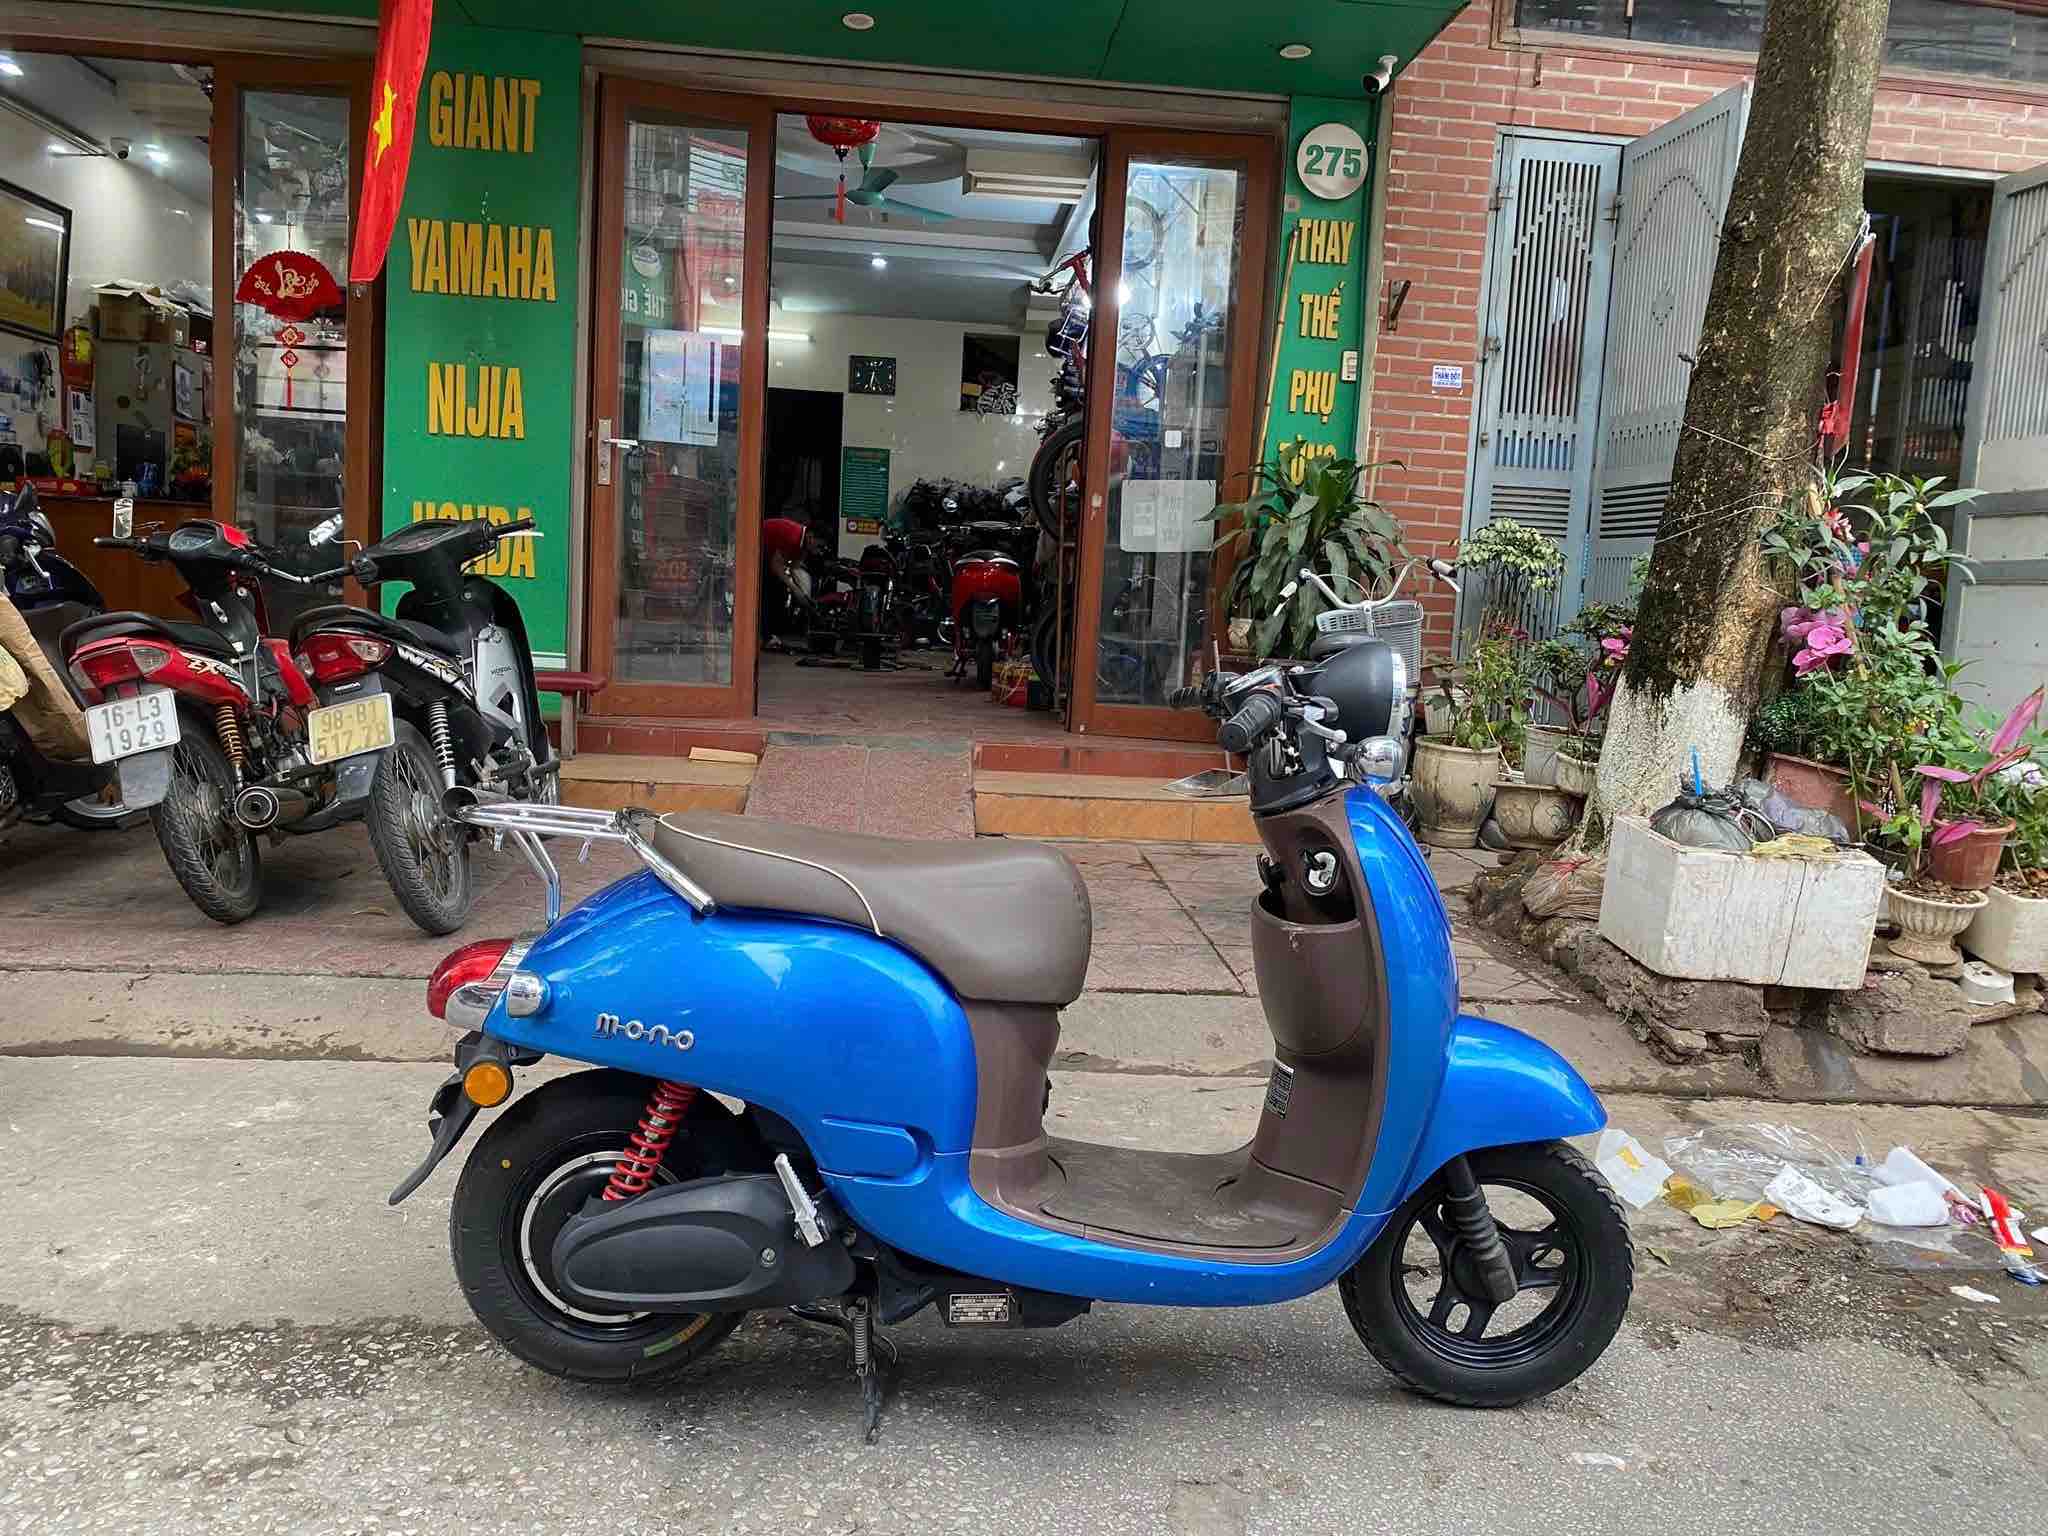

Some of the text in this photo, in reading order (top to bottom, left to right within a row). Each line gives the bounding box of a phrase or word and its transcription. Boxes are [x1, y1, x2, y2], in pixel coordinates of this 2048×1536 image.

[430, 71, 541, 152] GIANT
[1304, 144, 1362, 178] 275
[407, 218, 556, 301] YAMAHA
[1299, 219, 1355, 264] THAY
[1300, 280, 1345, 339] THẾ
[428, 362, 524, 438] NIJIA
[1289, 368, 1337, 424] PHỤ
[101, 696, 161, 730] 16-L3
[105, 720, 166, 756] 1929
[321, 701, 378, 734] 98-B1
